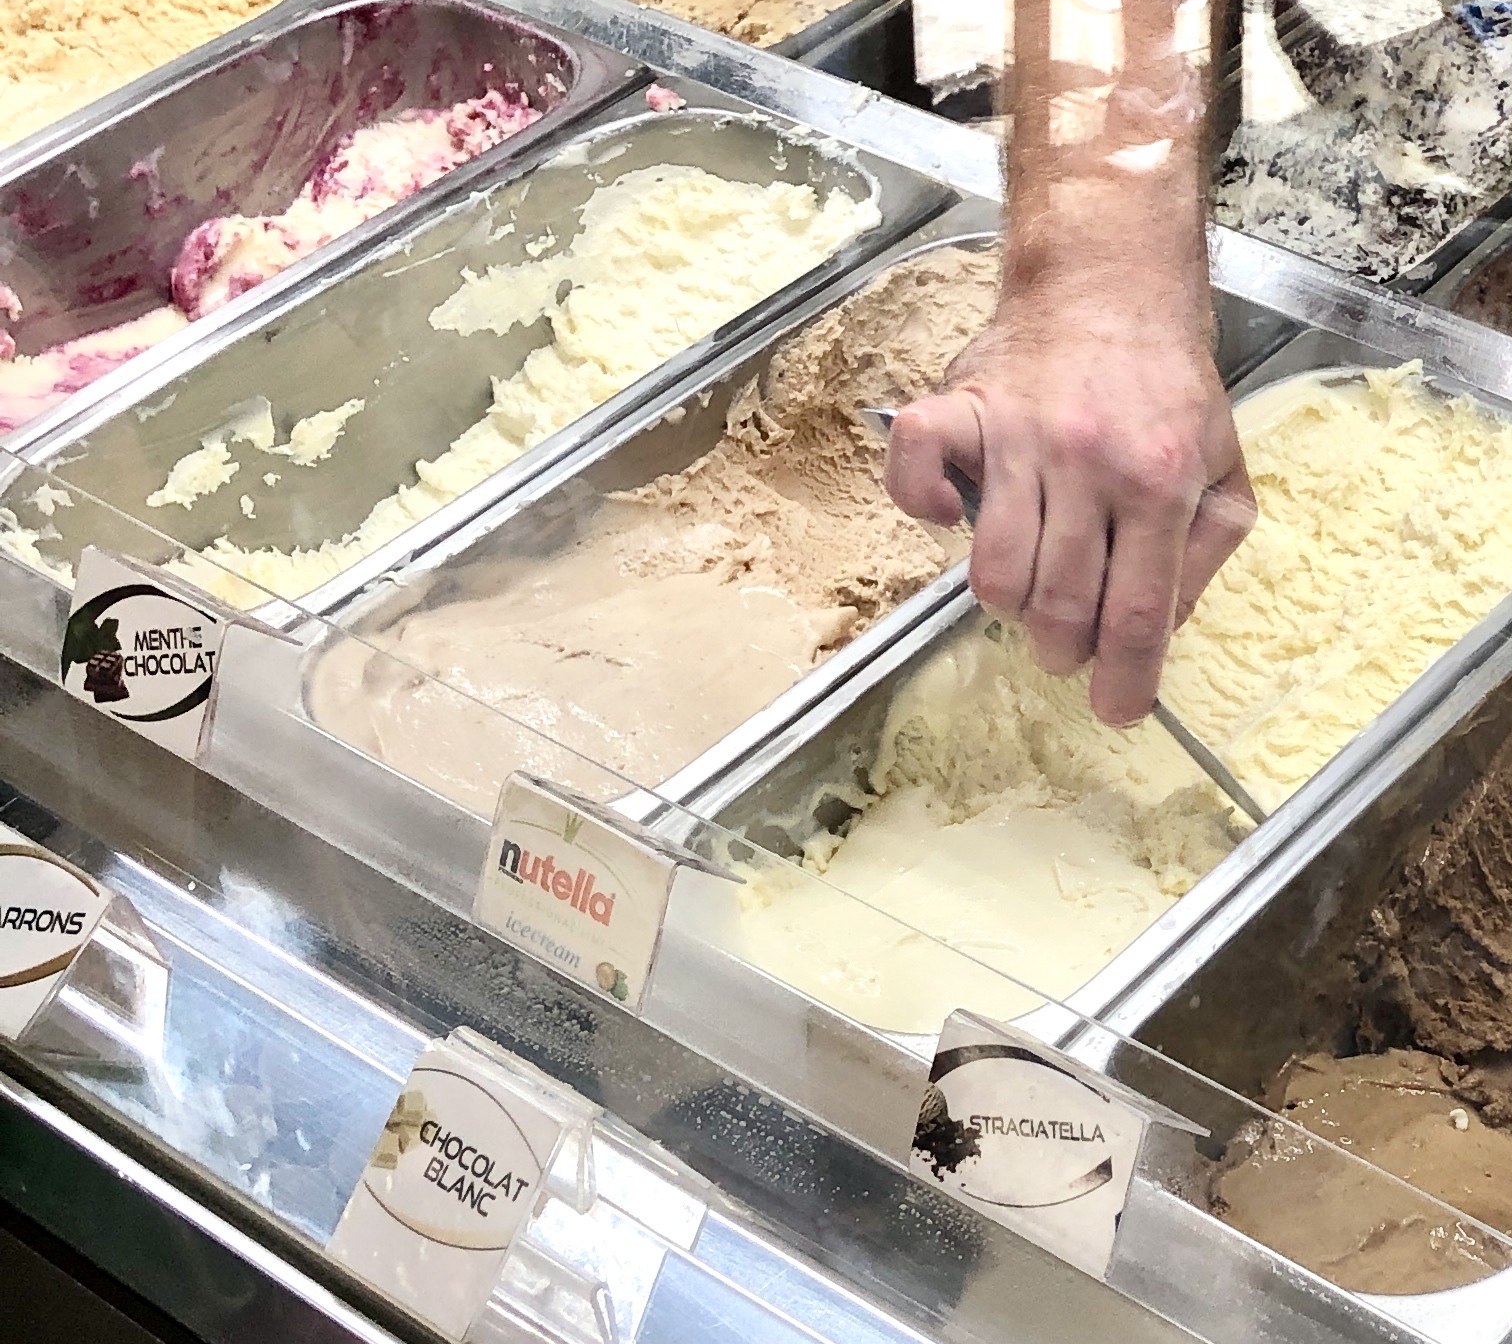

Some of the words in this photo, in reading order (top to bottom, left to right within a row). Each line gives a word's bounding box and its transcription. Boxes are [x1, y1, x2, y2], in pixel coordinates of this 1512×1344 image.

[133, 626, 203, 652] MENTHE
[123, 650, 216, 677] CHOCOLAT
[499, 838, 615, 927] nutella
[0, 906, 87, 935] RRONS
[969, 1114, 1106, 1143] STRACIATELLA
[419, 1119, 529, 1203] CHOCOLAT
[423, 1156, 497, 1218] BLANC
